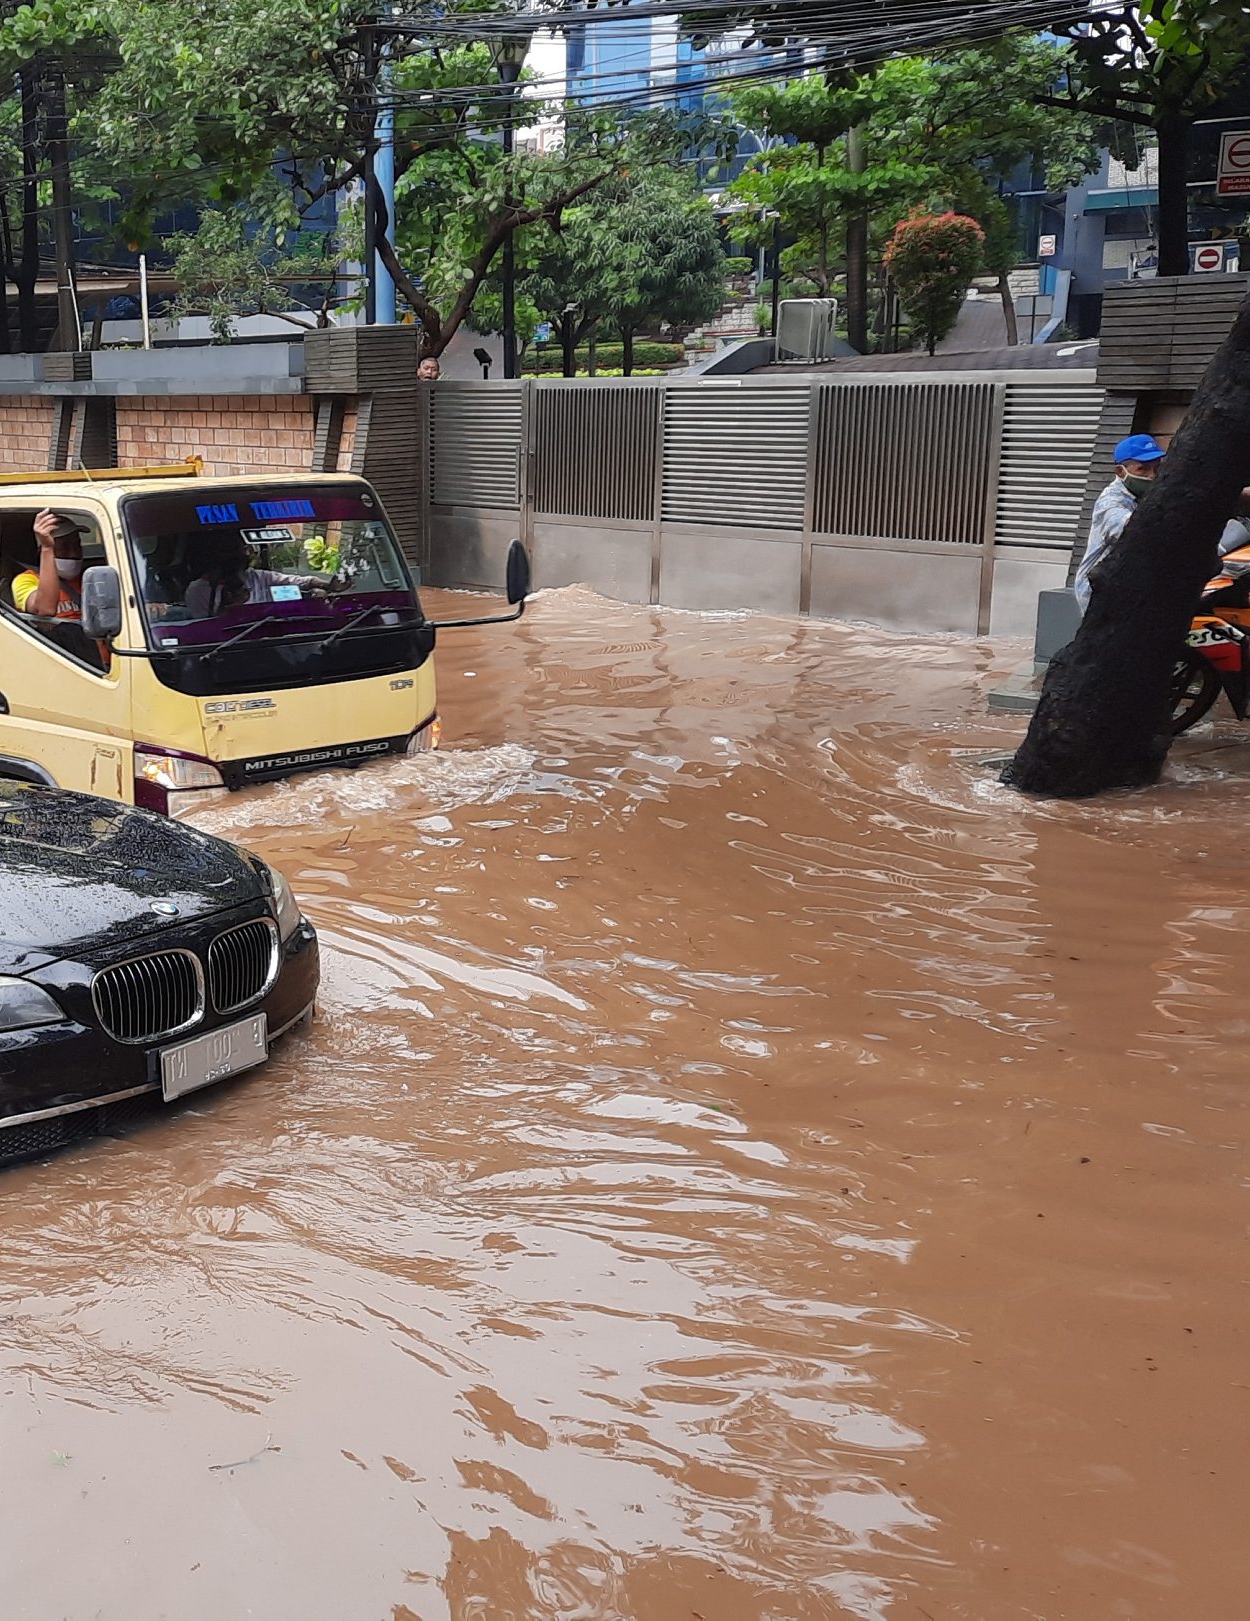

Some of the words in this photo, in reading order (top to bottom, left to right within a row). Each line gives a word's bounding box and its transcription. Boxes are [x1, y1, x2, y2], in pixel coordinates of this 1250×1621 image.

[239, 698, 277, 711] DIESEL
[245, 749, 342, 771] MITSUBISHI
[346, 741, 390, 757] FUSO
